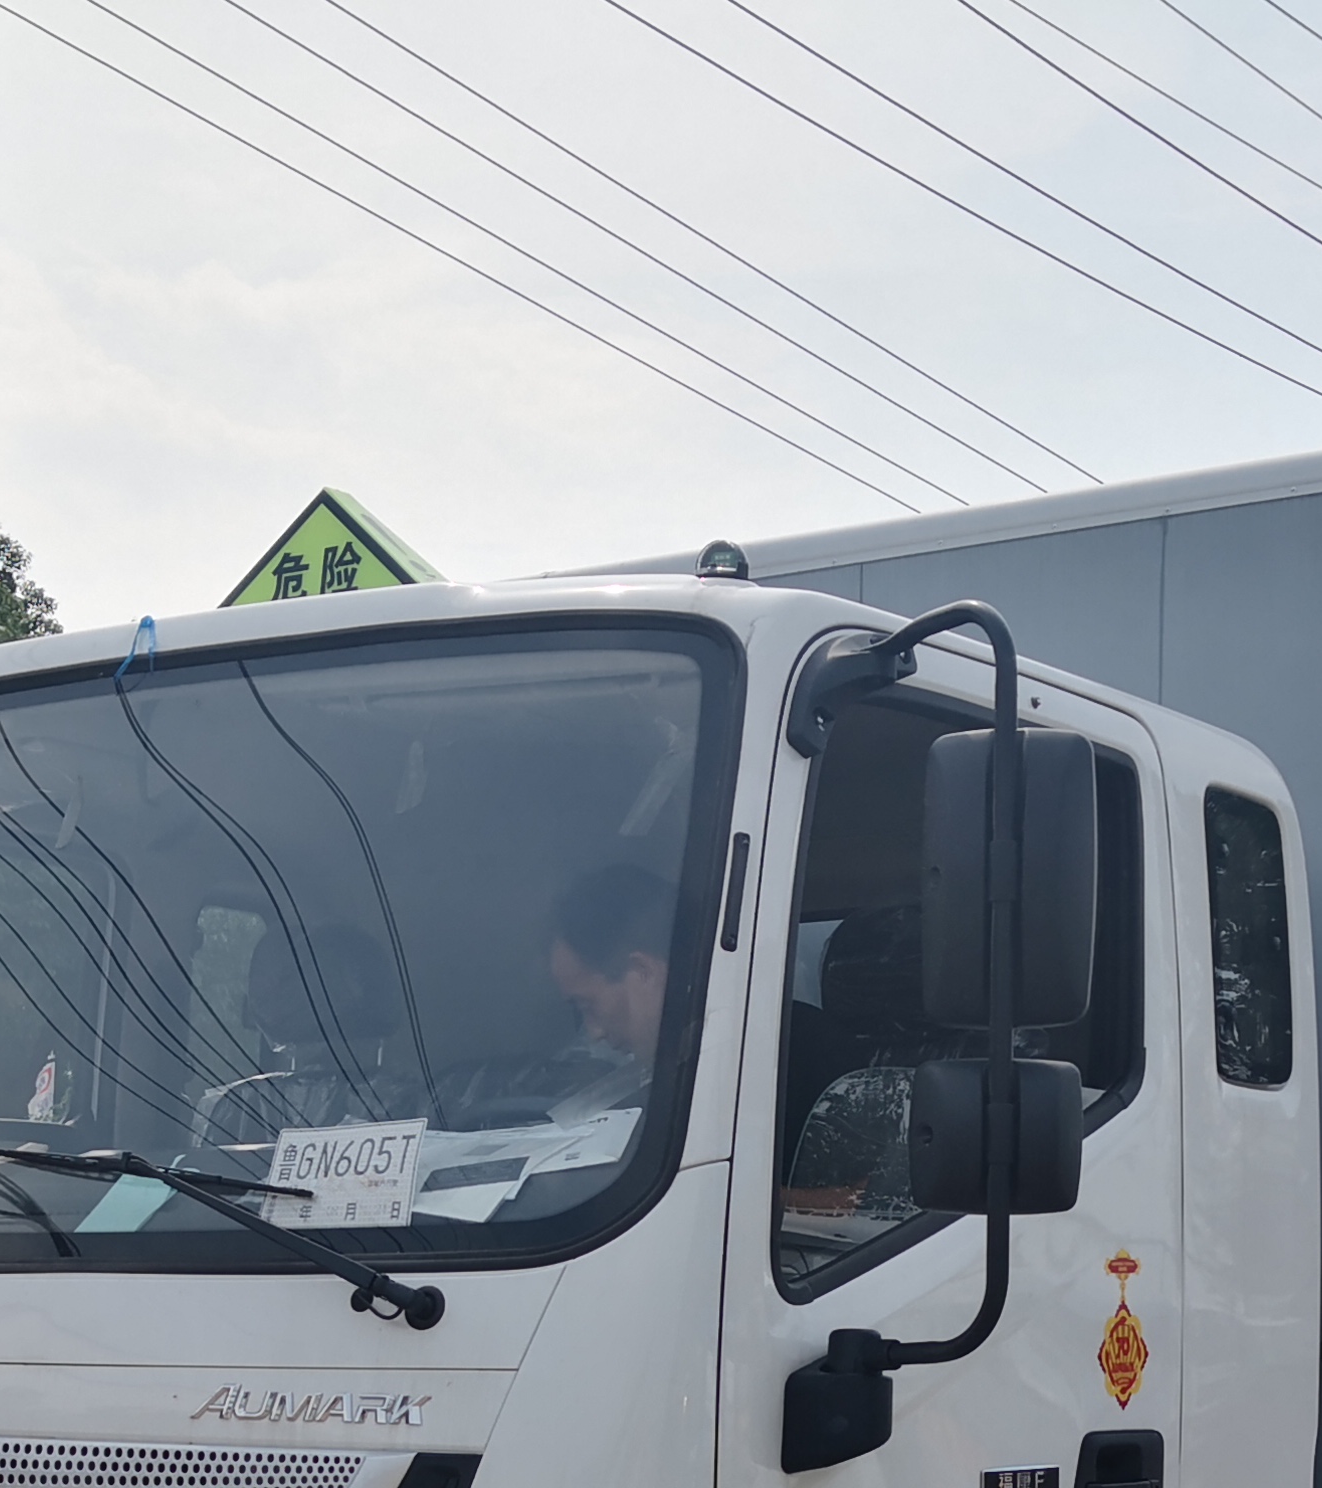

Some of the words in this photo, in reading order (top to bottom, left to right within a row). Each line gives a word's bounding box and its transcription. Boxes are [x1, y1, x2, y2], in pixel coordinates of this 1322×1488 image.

[271, 541, 362, 600] 危险
[278, 1134, 417, 1182] 鲁GN605T
[344, 1202, 357, 1221] 月
[390, 1201, 401, 1220] 日
[190, 1383, 433, 1426] AUMARK
